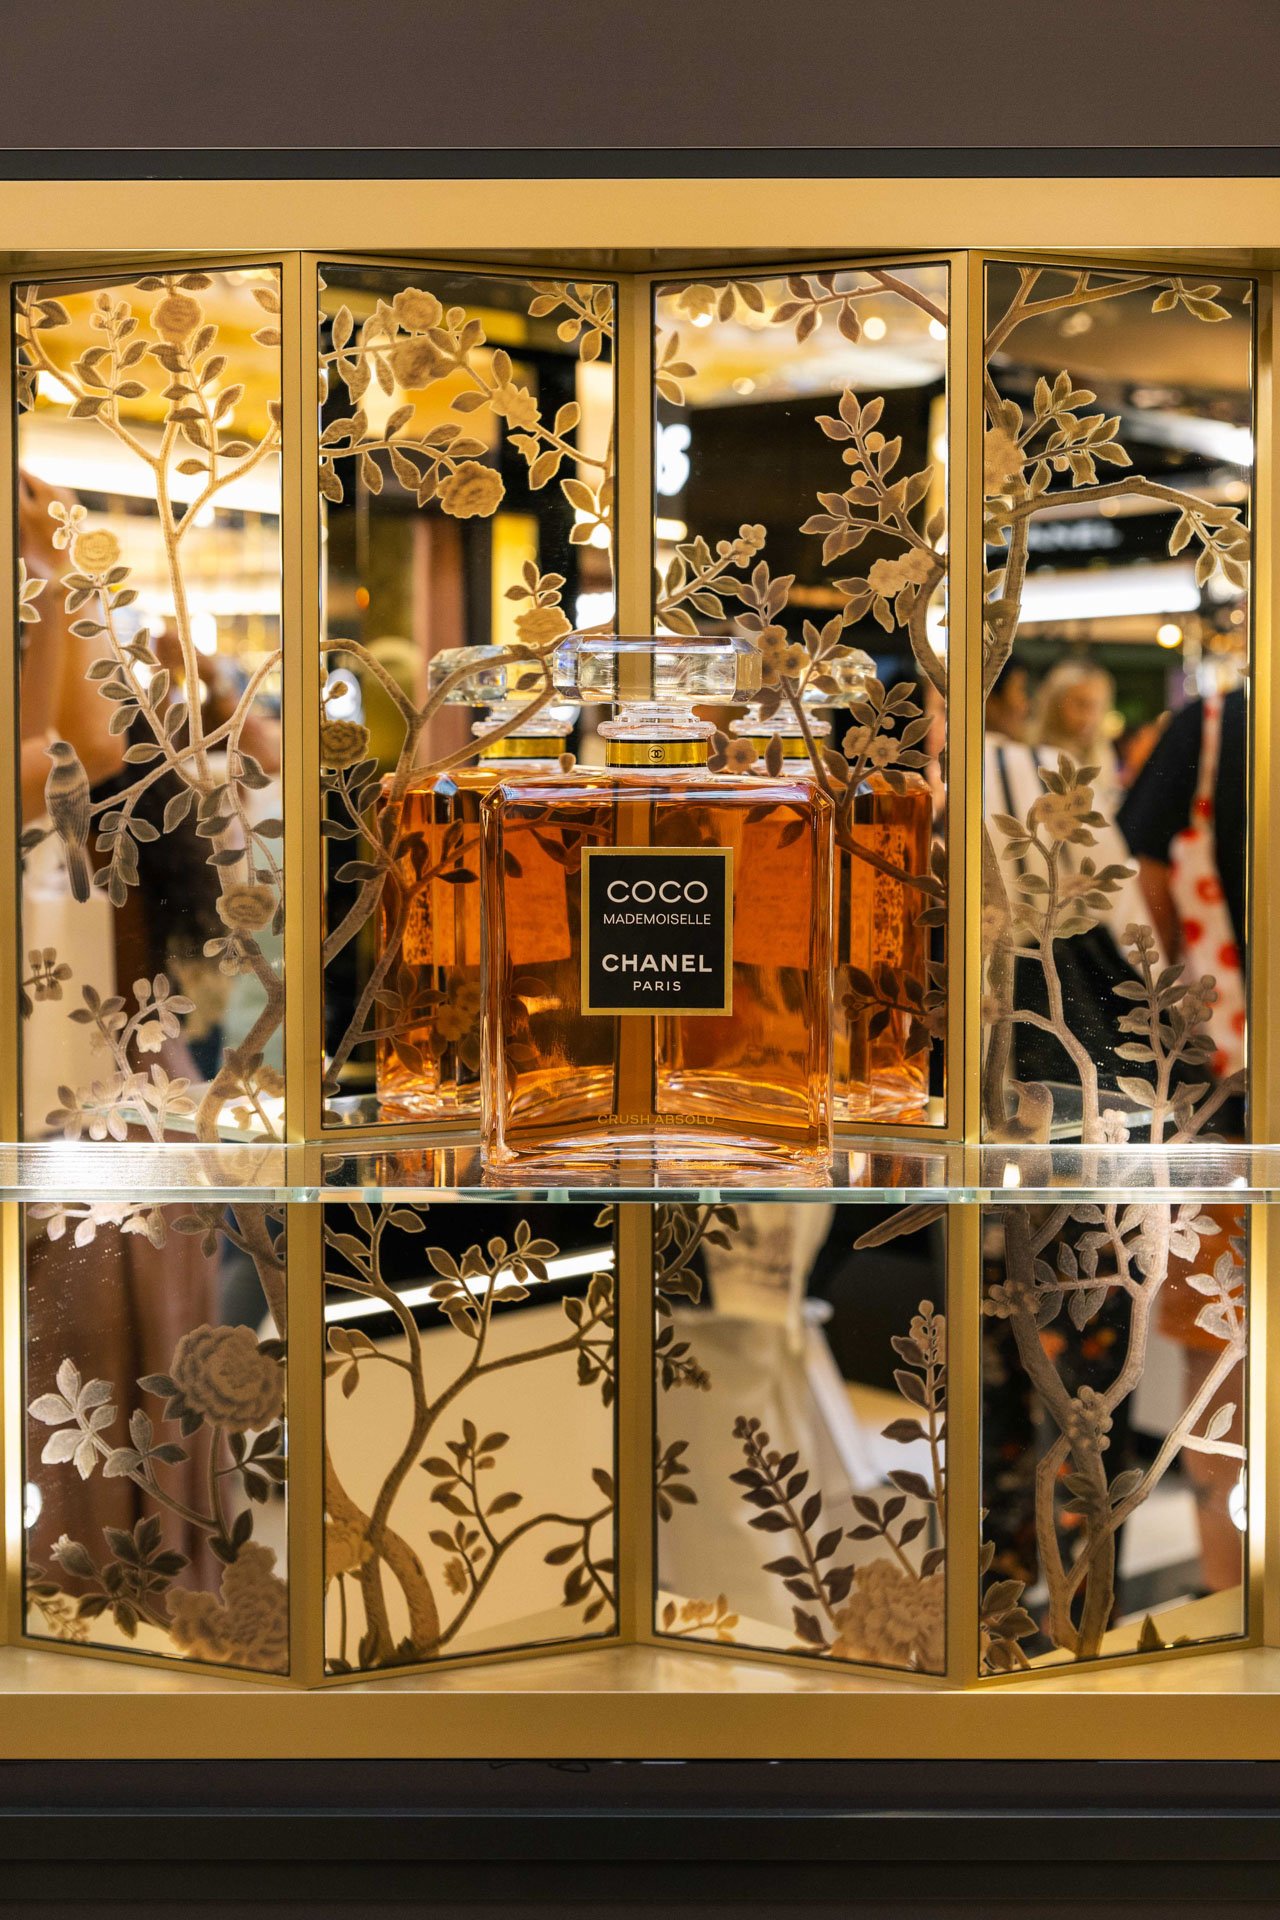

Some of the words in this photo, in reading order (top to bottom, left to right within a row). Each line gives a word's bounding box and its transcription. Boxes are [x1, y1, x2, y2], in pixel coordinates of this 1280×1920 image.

[607, 880, 708, 903] COCO
[603, 913, 711, 925] MADEMOISELLE
[602, 954, 712, 972] CHANEL
[633, 981, 681, 991] PARIS
[598, 1114, 650, 1125] CRUSH
[653, 1114, 715, 1125] ABSOLU
